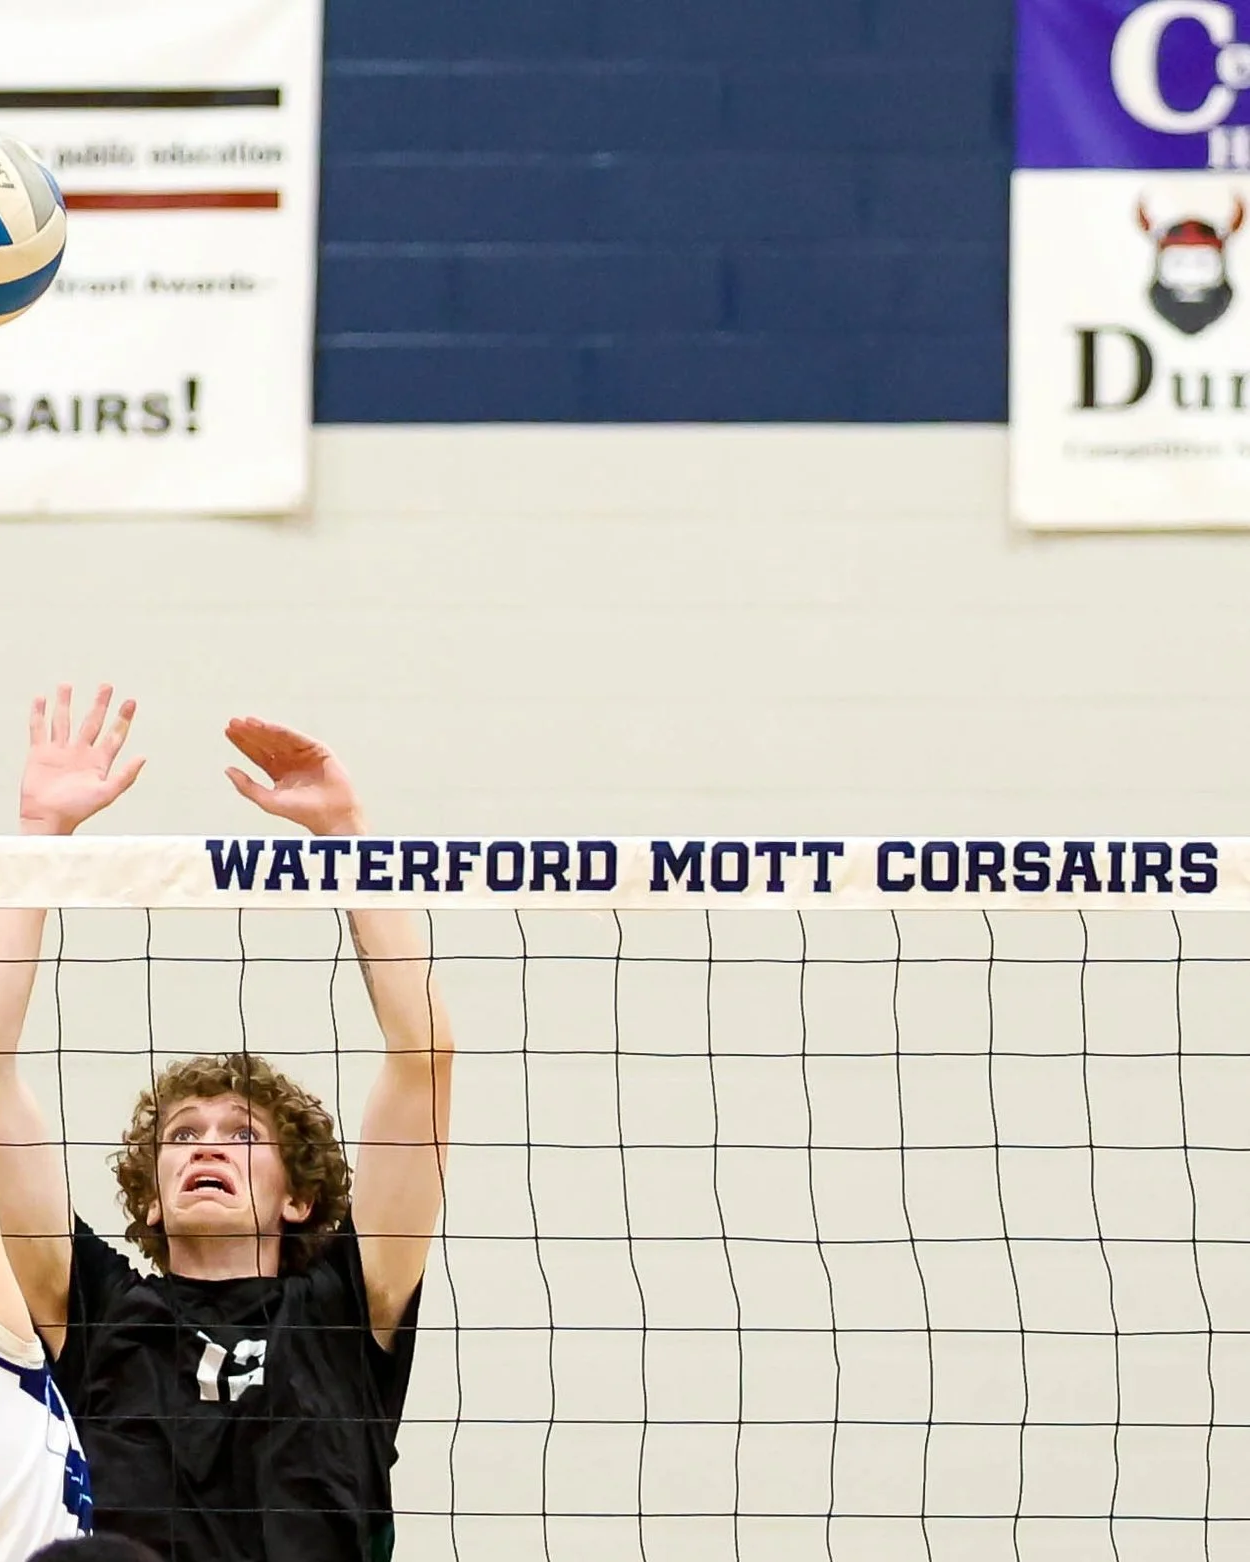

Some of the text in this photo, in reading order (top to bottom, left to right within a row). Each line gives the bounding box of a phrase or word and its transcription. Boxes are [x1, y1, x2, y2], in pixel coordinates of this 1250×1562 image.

[206, 840, 1218, 894] WATERFORD MOTT CORSAIRS
